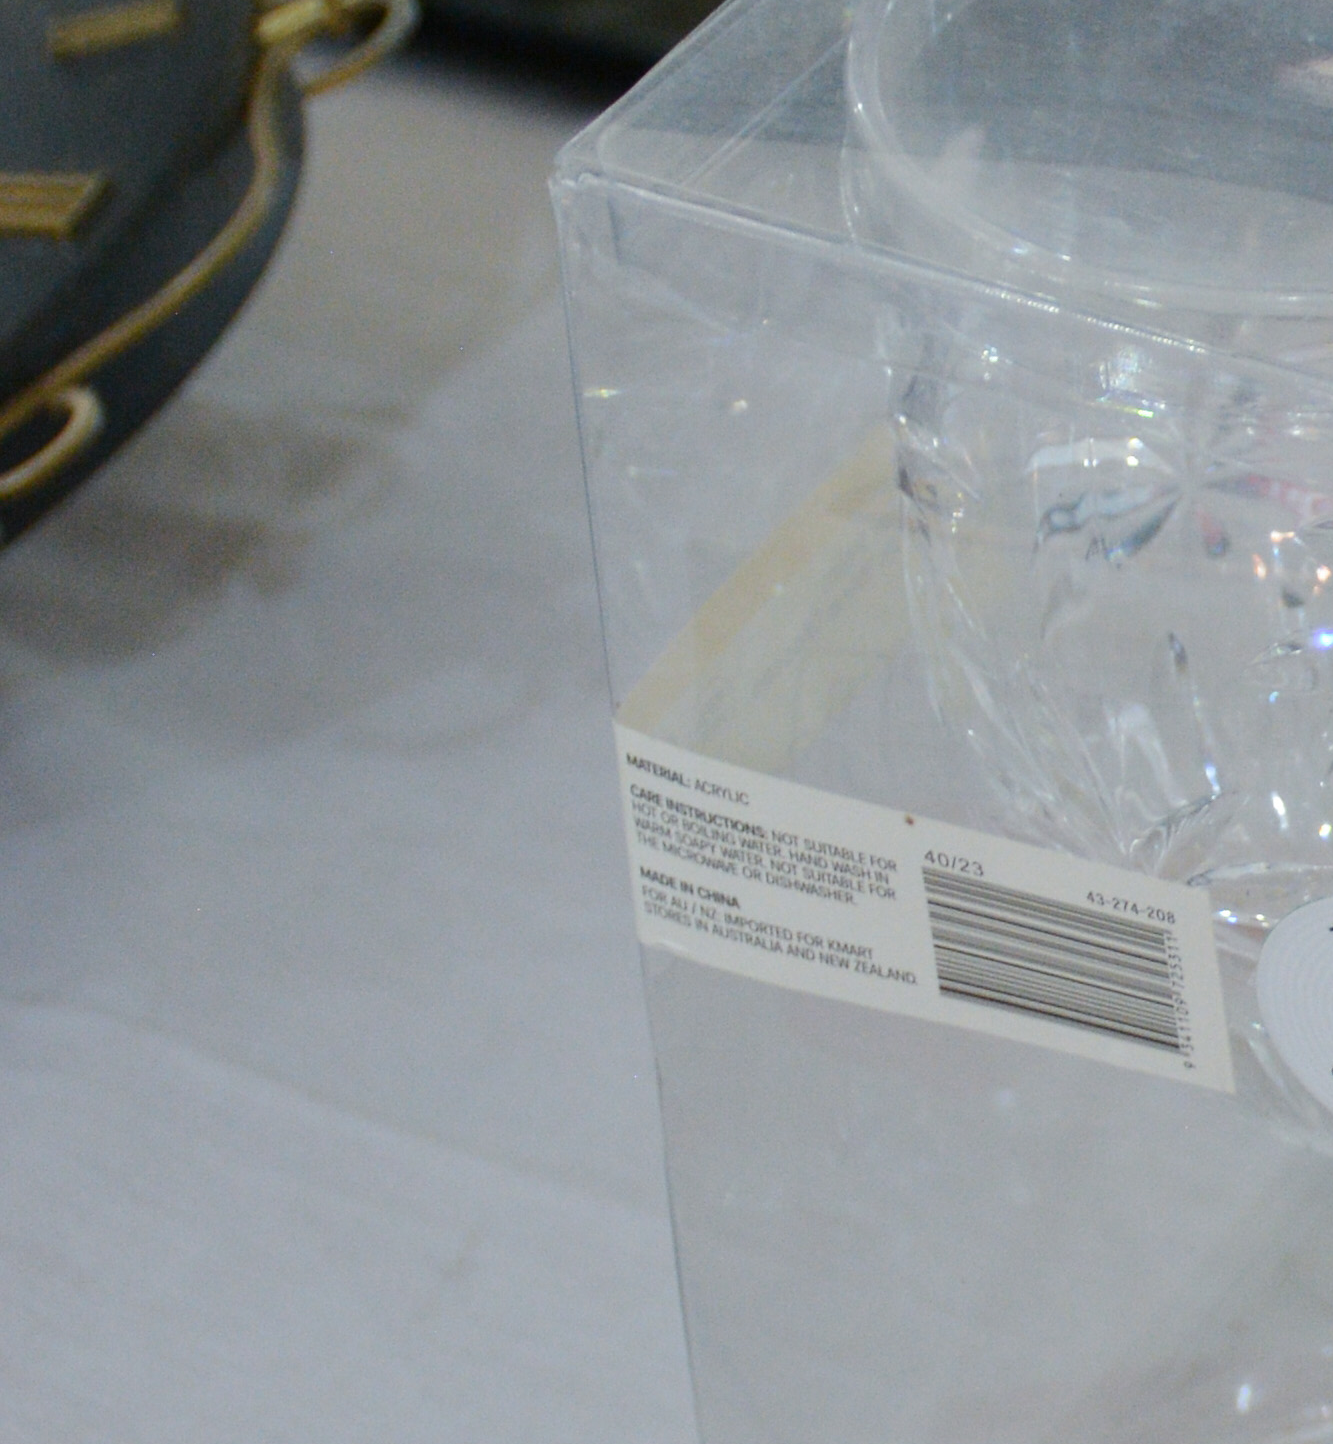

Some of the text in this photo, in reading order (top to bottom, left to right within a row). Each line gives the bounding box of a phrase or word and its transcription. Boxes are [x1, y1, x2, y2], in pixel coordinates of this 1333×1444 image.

[626, 752, 749, 806] MATERIAL: ACRYLIC
[630, 783, 661, 807] CARE
[771, 829, 798, 847] NOT
[804, 838, 866, 864] SUITABLE
[869, 854, 897, 872] FOR
[742, 864, 762, 882] OR
[770, 859, 797, 876] NOT
[802, 866, 865, 893] SUITABLE
[869, 882, 897, 900] FOR
[789, 849, 828, 869] HAND
[831, 860, 871, 880] WASH
[924, 849, 985, 878] 40/23
[640, 865, 741, 910] MADE IN CHINA
[1086, 890, 1177, 925] 43-274-208
[711, 923, 783, 954] AUSTRALIA
[786, 942, 816, 962] AND
[819, 951, 850, 970] NEW
[723, 912, 794, 942] IMPORTED
[797, 930, 824, 948] FOR
[827, 938, 874, 960] KMART
